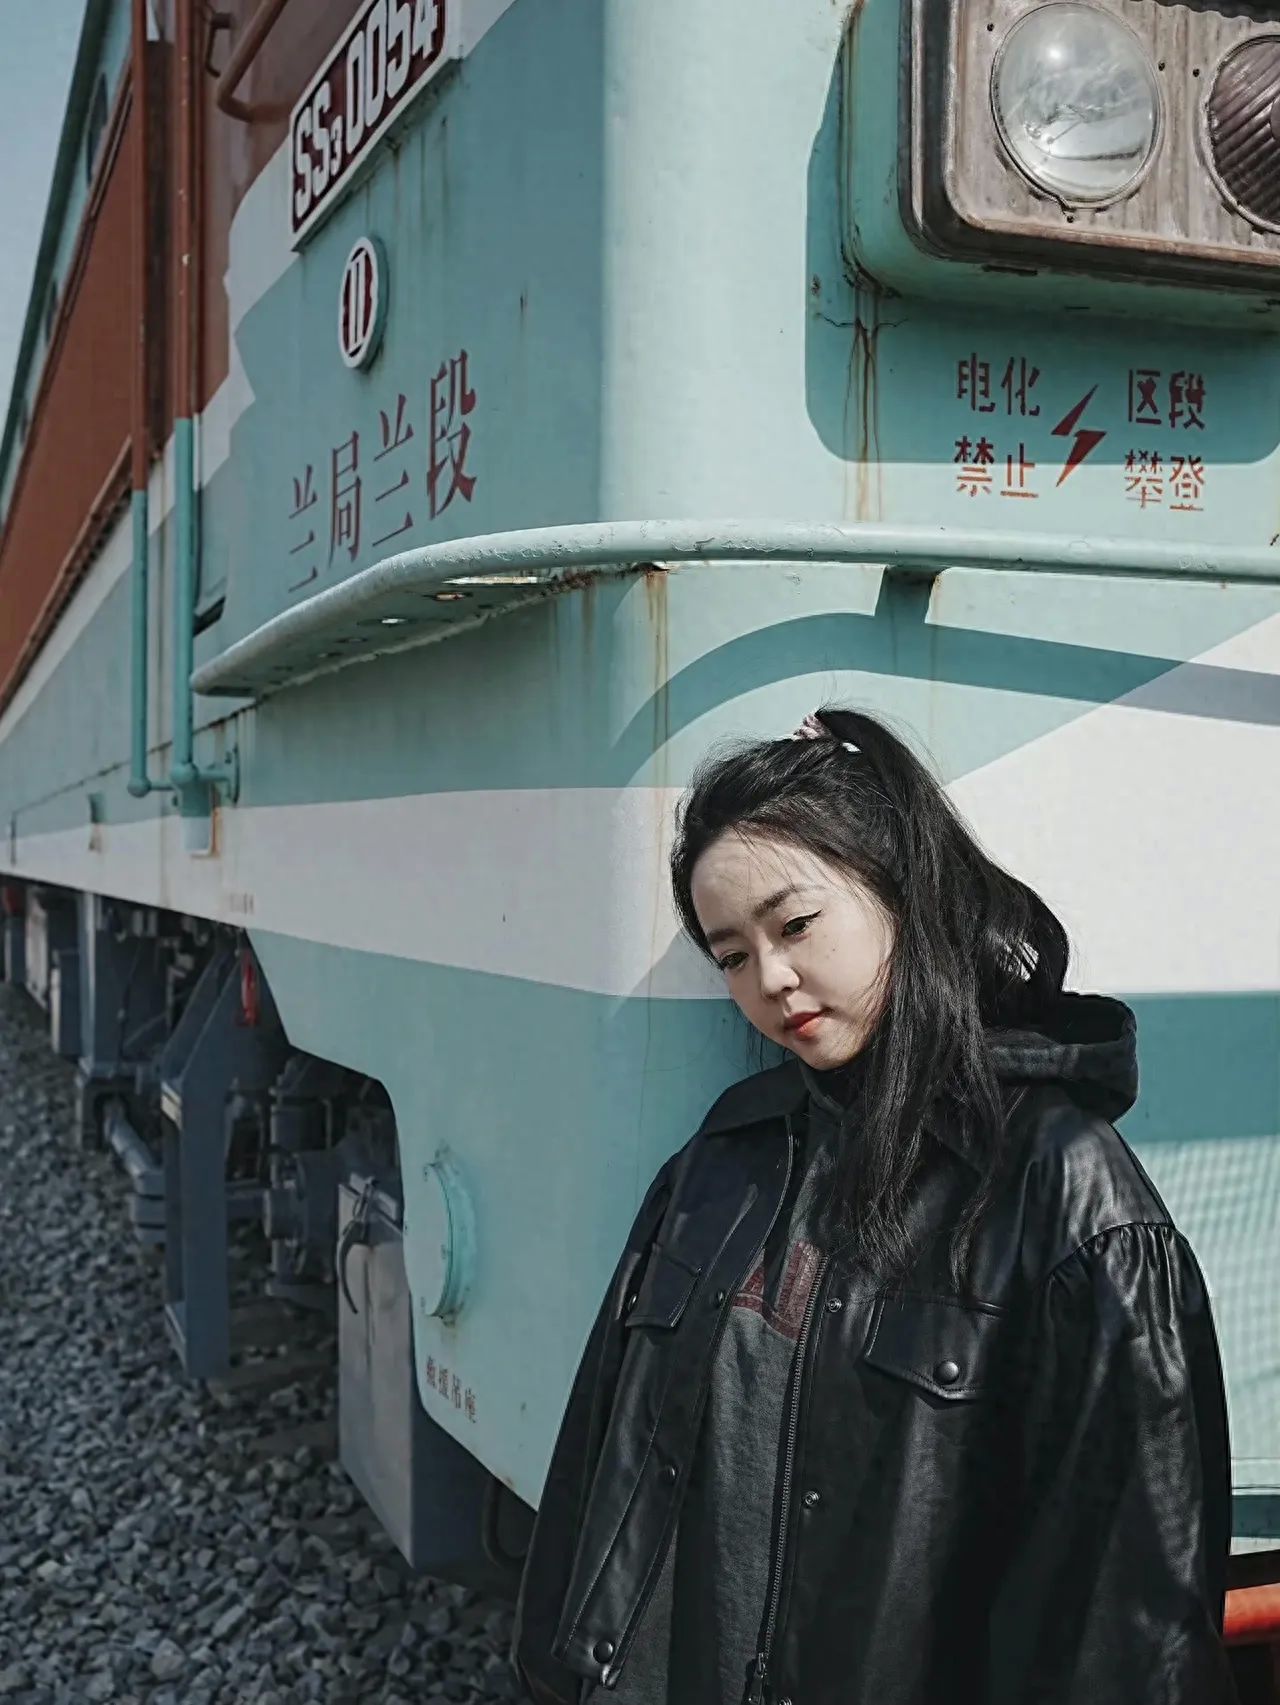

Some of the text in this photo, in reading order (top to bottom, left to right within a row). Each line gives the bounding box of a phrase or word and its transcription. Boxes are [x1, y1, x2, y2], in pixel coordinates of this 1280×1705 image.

[956, 352, 1206, 430] 电化 区段
[288, 348, 476, 593] 兰局兰段
[953, 435, 1205, 512] 禁止 攀登
